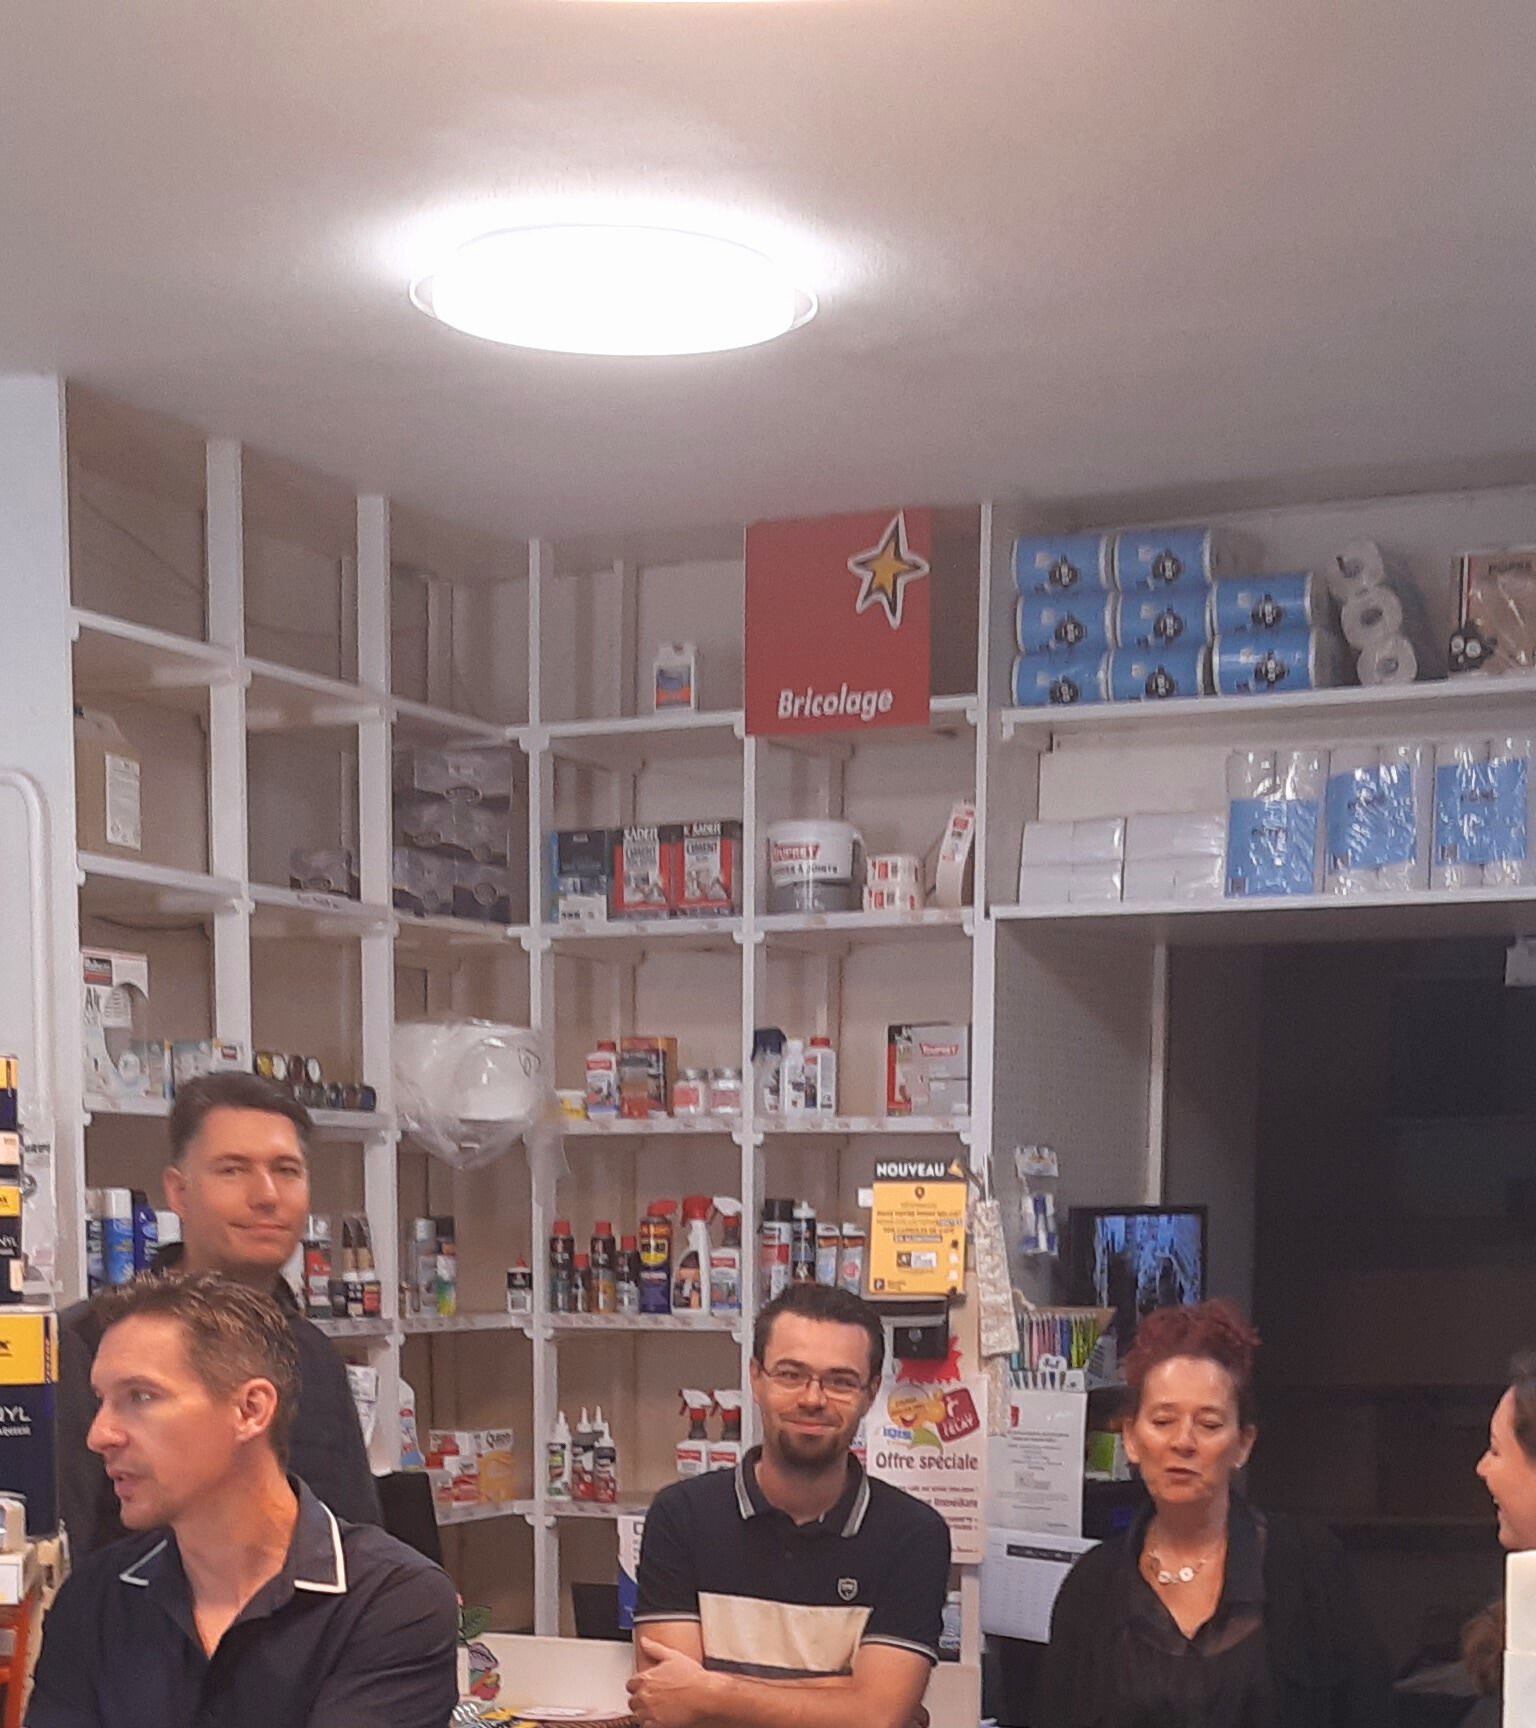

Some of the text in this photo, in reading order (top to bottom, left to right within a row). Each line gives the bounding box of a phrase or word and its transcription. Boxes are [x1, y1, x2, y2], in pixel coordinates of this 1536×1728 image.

[778, 683, 894, 722] Bricolage
[876, 1162, 945, 1178] NOUVEAU
[876, 1452, 915, 1470] Offre
